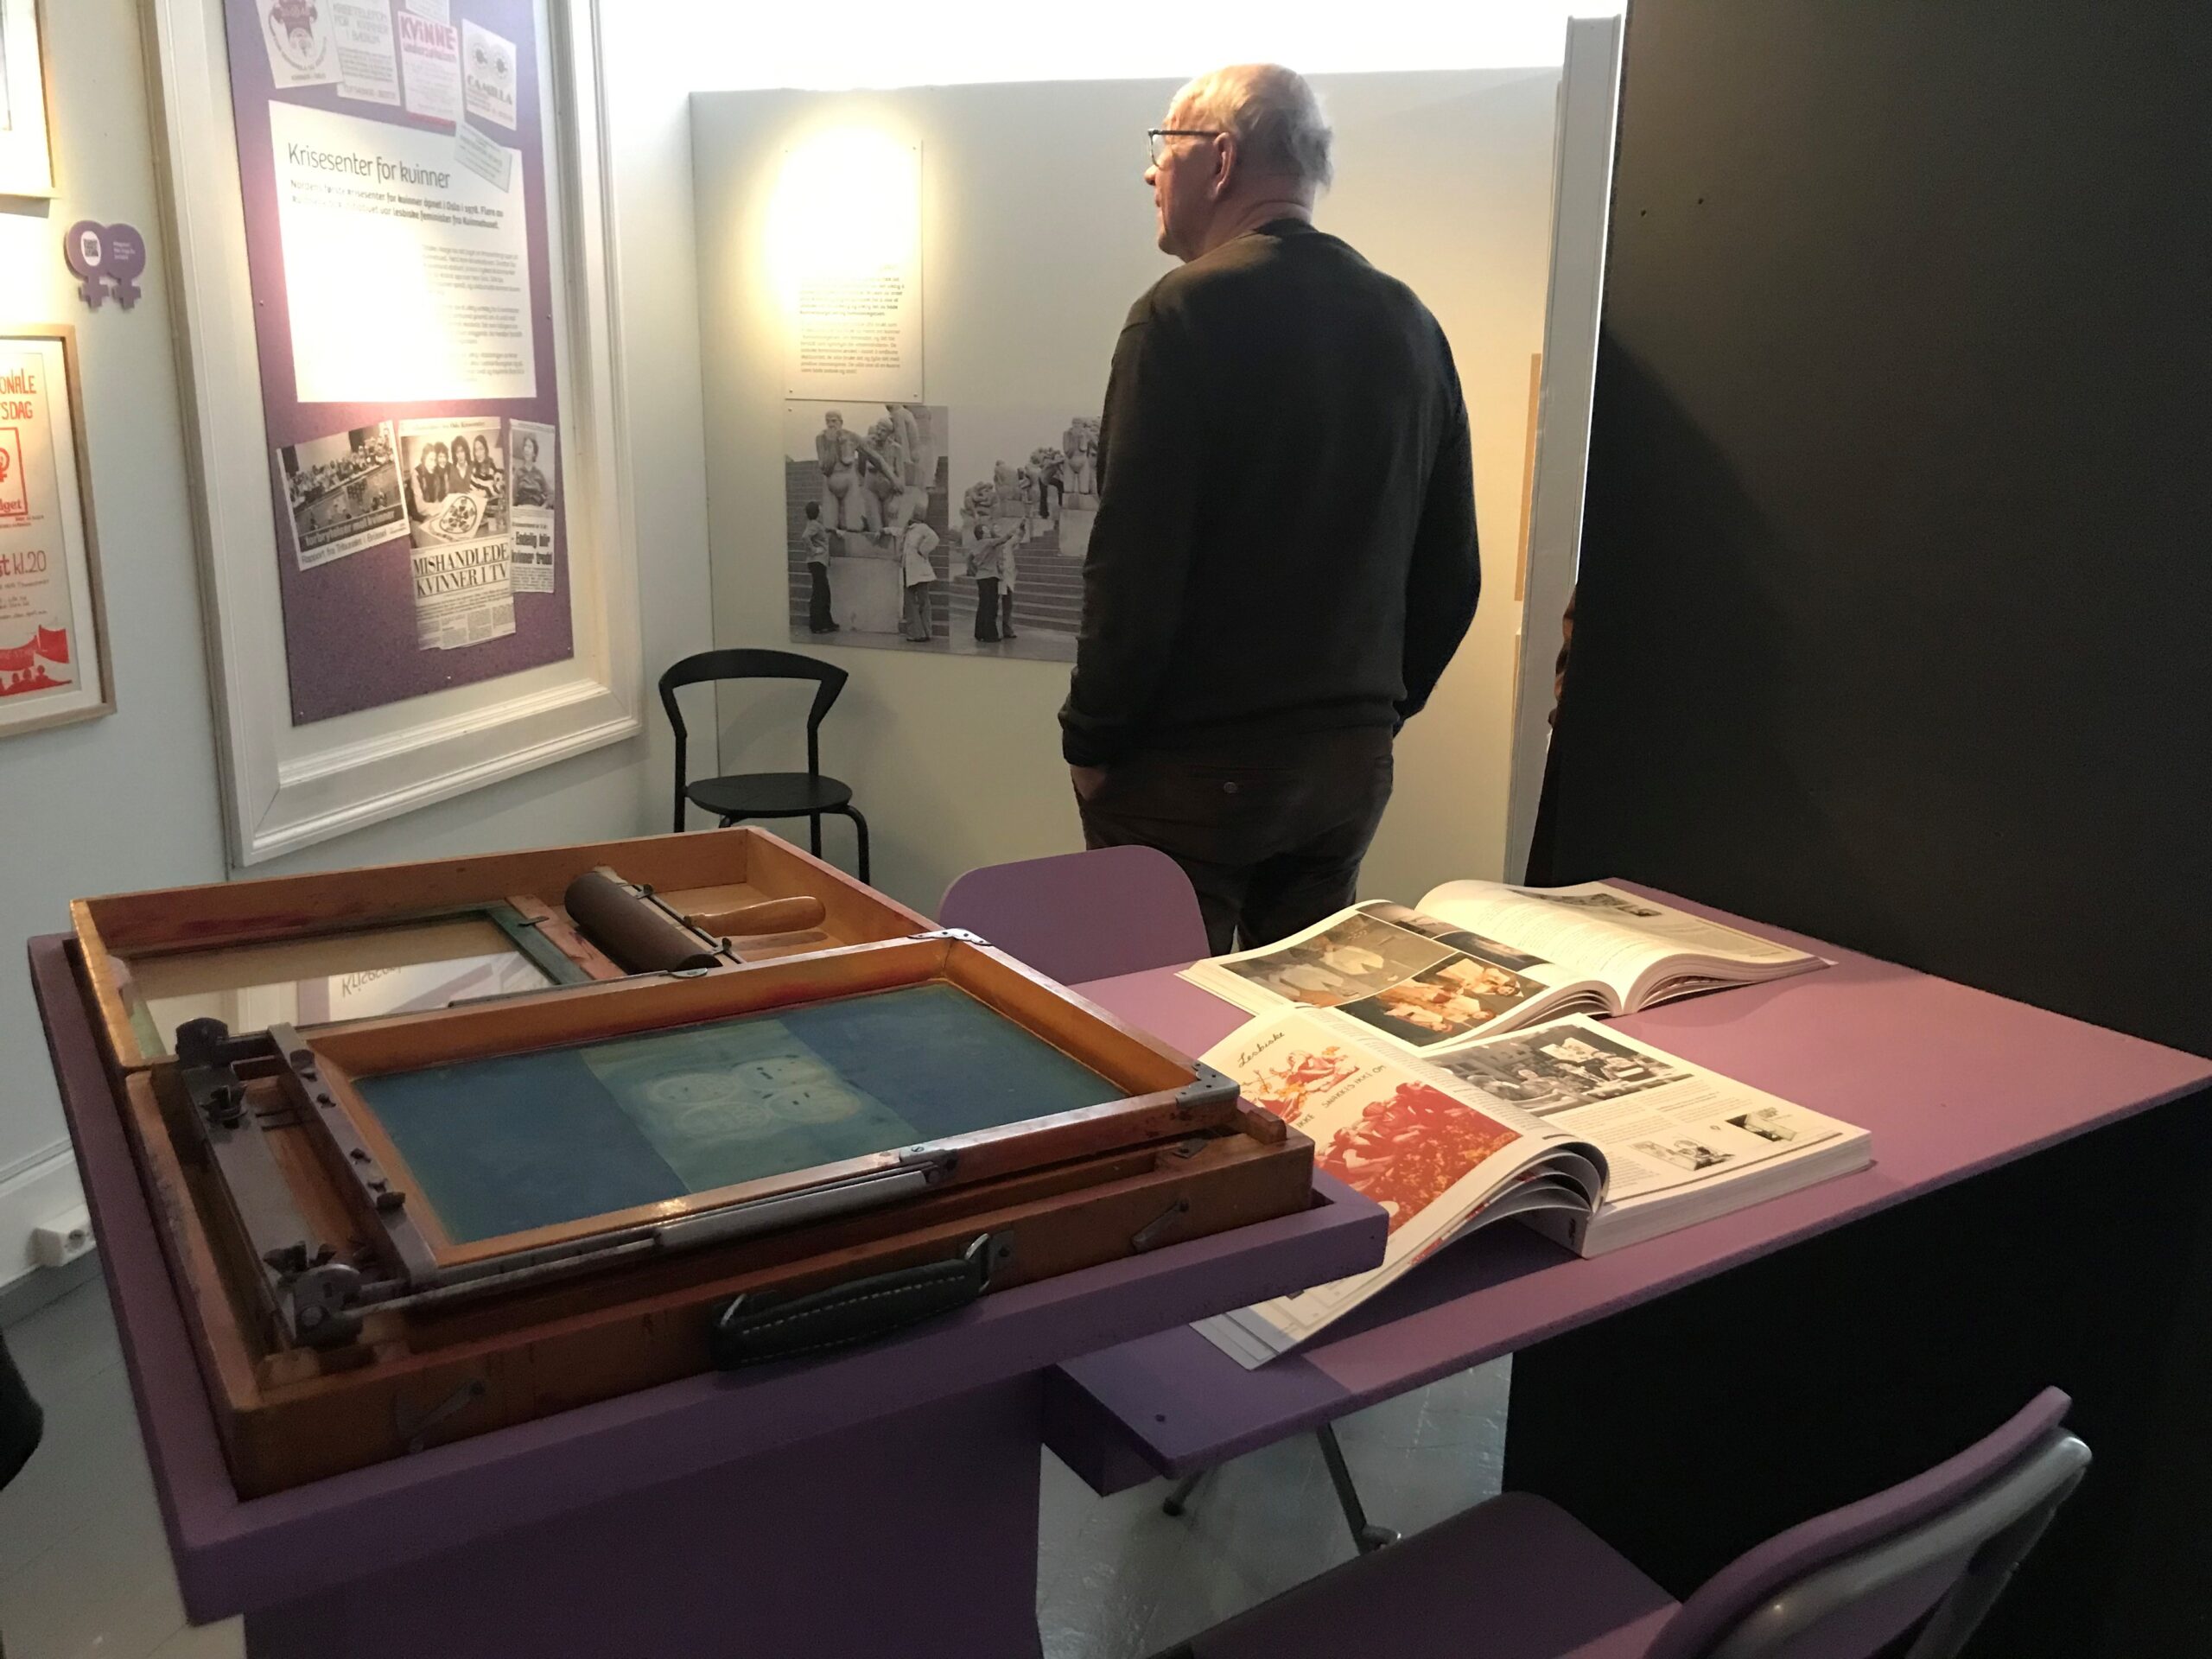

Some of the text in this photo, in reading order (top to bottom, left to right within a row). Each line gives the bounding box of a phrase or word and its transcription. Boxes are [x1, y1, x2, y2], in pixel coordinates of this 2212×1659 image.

[400, 15, 456, 51] KVINNE
[288, 142, 373, 177] Krisesenter
[376, 156, 397, 184] for
[0, 401, 33, 420] SDAG
[412, 542, 510, 577] MISHANDLEDE
[416, 567, 478, 597] KVINNER
[490, 562, 508, 582] TV
